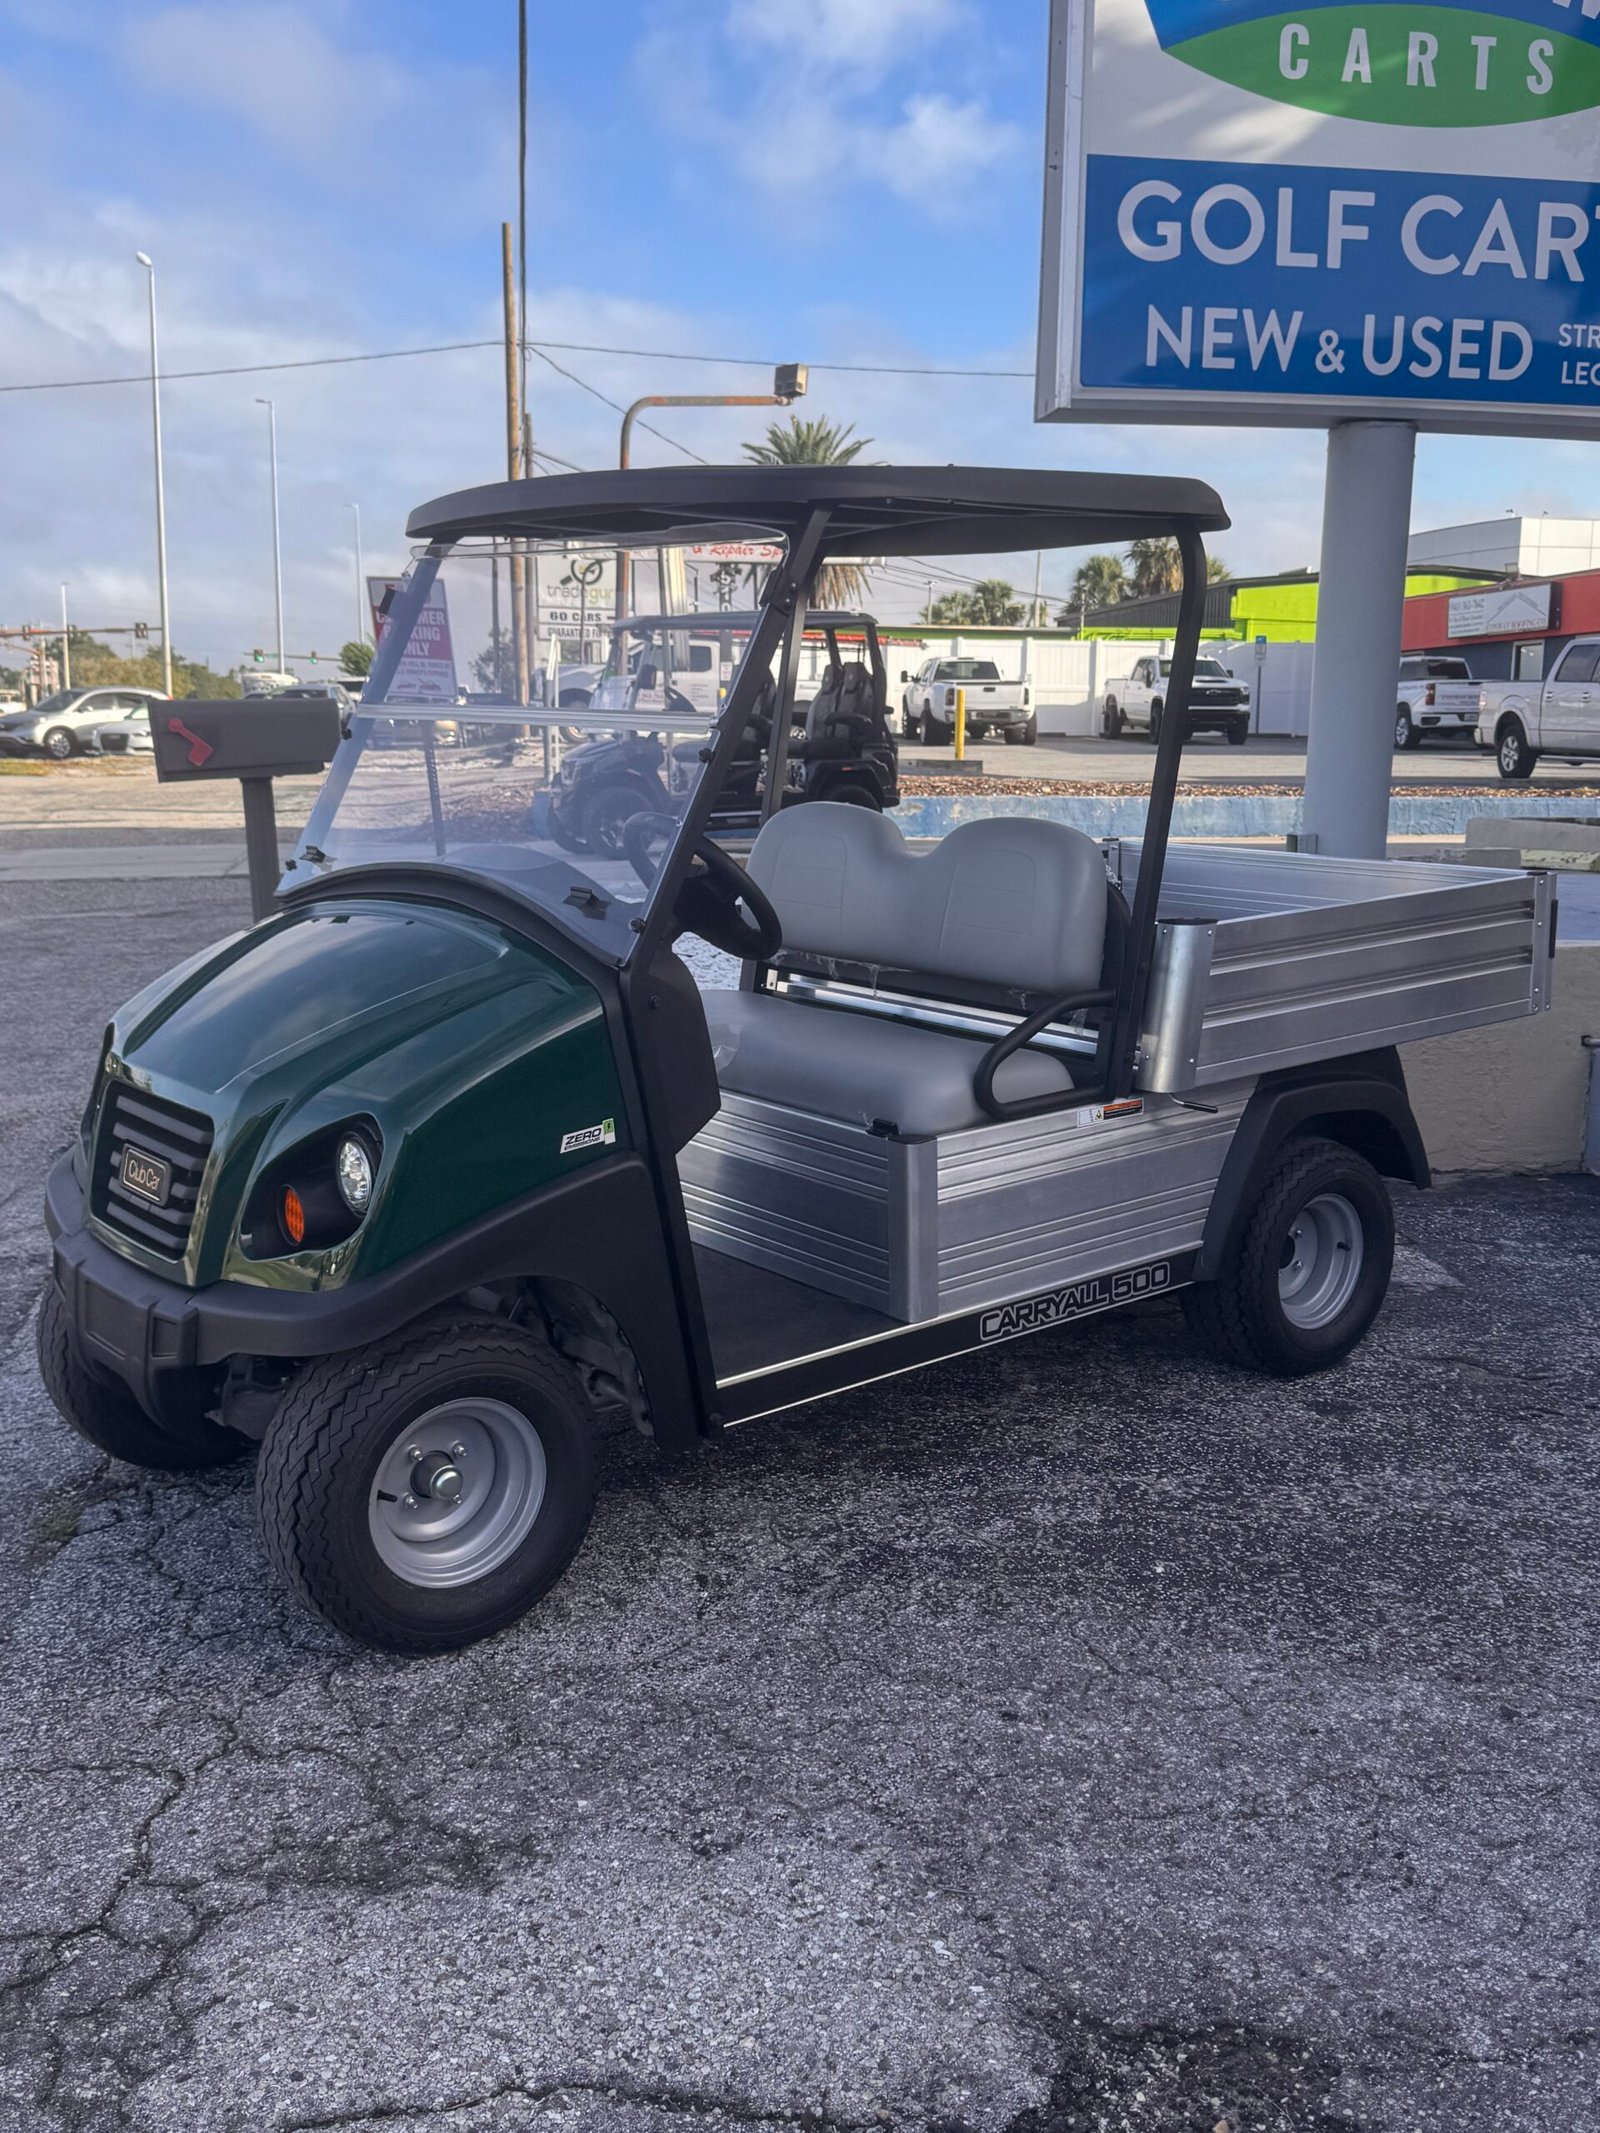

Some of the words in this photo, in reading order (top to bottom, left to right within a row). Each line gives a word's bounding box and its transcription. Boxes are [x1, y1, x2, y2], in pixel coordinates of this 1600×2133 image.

[1278, 23, 1555, 95] CARTS
[1117, 180, 1376, 269] GOLF
[1401, 194, 1600, 282] CAR
[1146, 304, 1303, 372] NEW
[1315, 329, 1345, 374] &
[1362, 314, 1533, 381] USED
[1558, 323, 1600, 349] STR
[376, 609, 446, 625] CMER
[550, 612, 568, 621] 60
[383, 625, 441, 641] PKING
[402, 641, 430, 656] NLY
[565, 1128, 602, 1146] ZERO
[980, 1281, 1109, 1341] CARRYALL
[1112, 1262, 1170, 1300] 500
